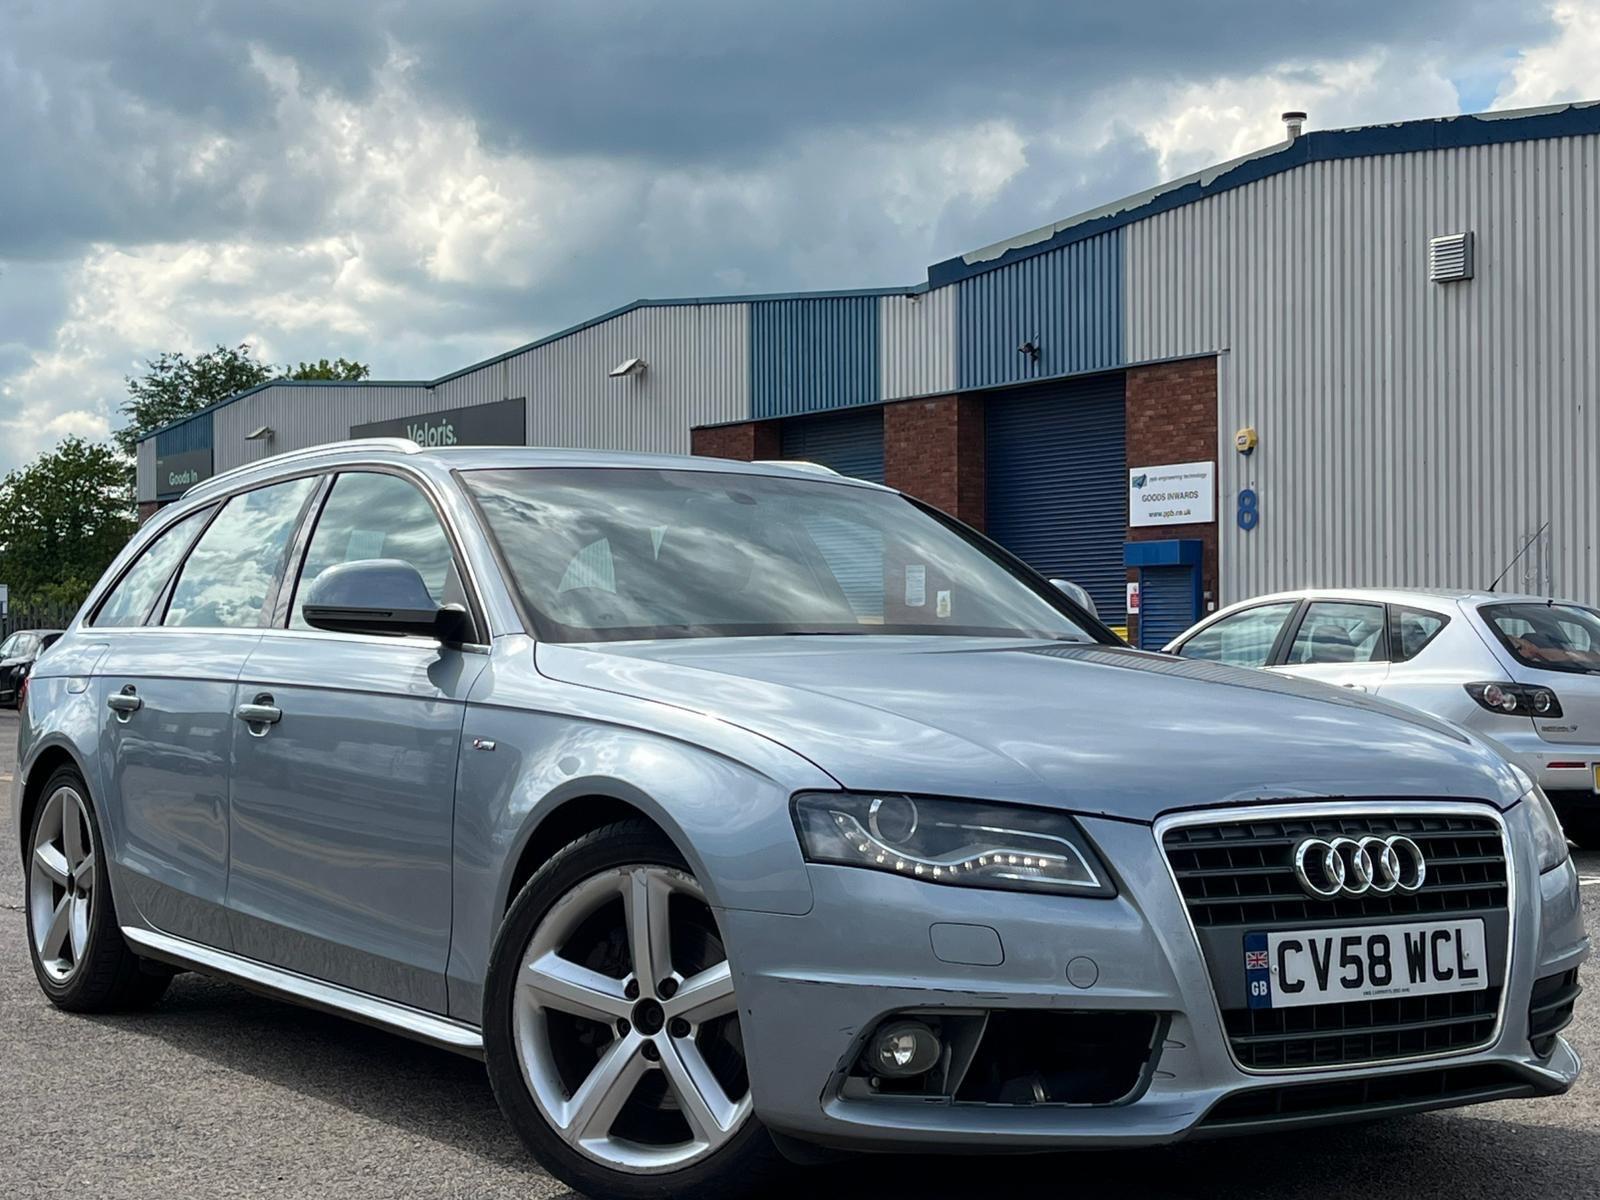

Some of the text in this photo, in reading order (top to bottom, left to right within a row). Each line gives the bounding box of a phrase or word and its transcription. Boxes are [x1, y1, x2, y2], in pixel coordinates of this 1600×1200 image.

[407, 418, 457, 447] Veloris.
[169, 469, 198, 486] Goods In
[1142, 490, 1199, 502] GOODS INWARDS
[1237, 489, 1259, 531] 8
[1277, 928, 1479, 994] CV58 WCL
[1251, 981, 1268, 997] GB
